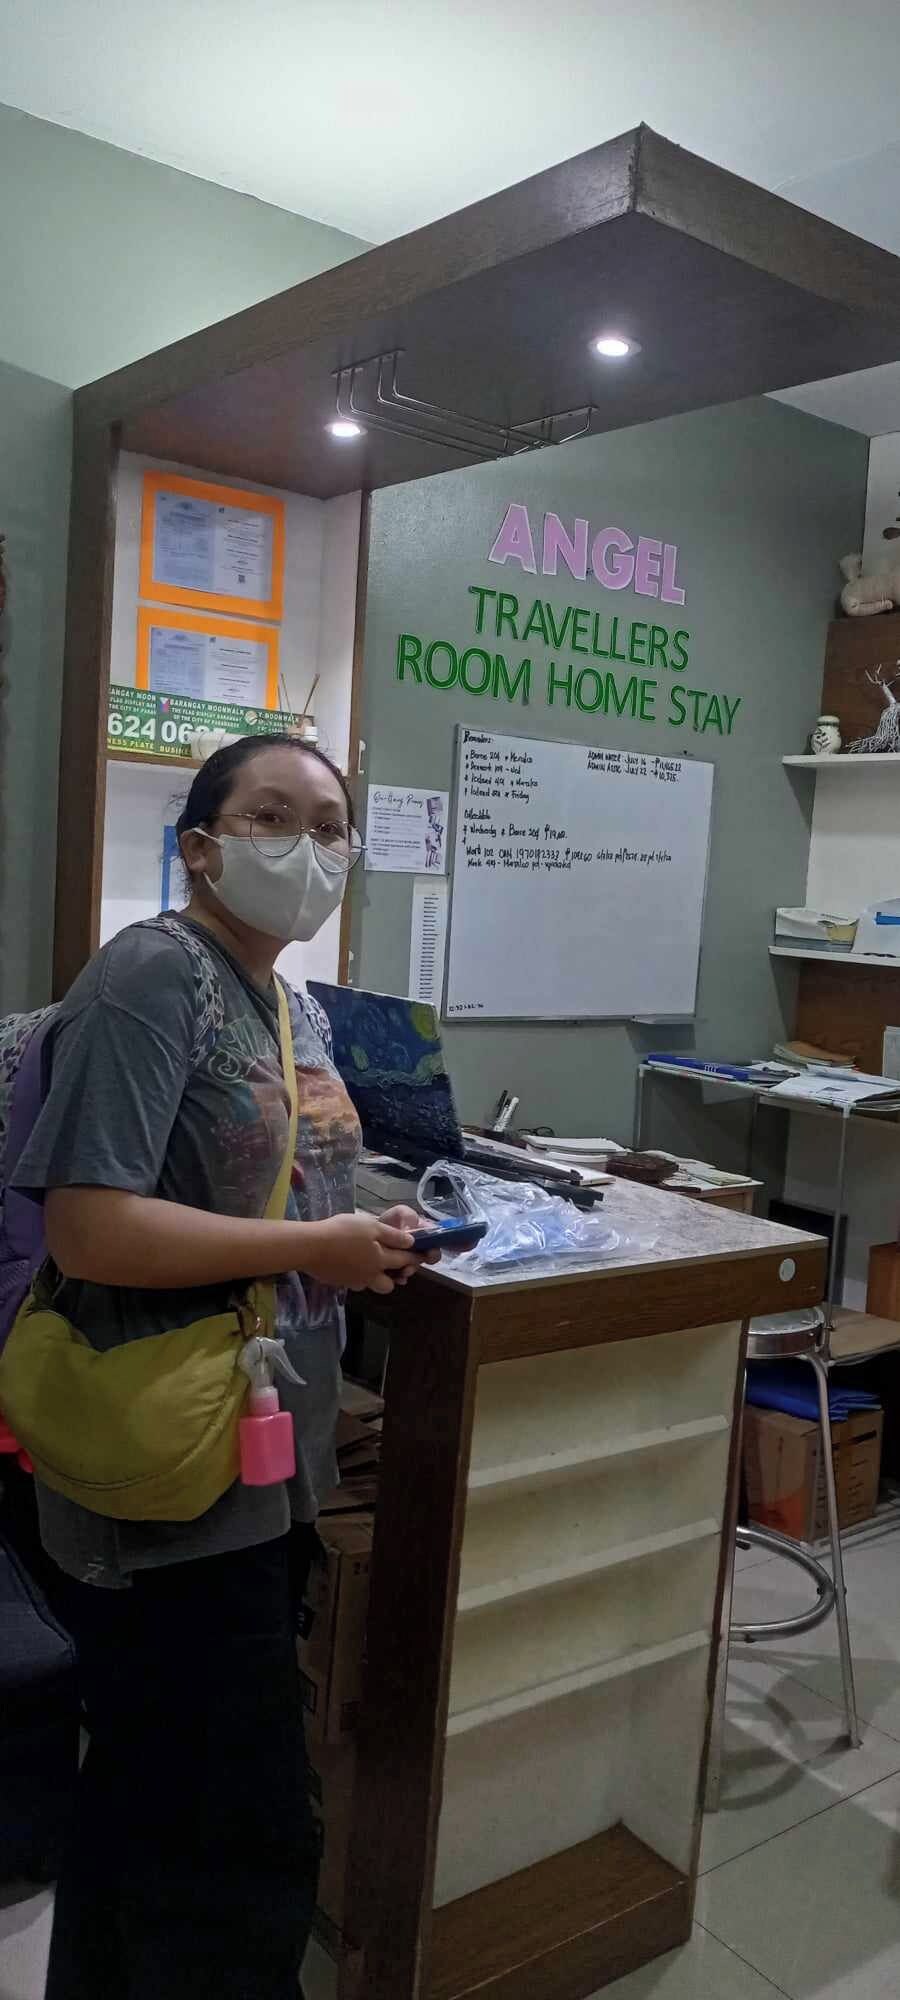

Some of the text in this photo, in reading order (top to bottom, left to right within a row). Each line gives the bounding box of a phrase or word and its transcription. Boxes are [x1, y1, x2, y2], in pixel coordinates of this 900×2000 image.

[487, 503, 686, 606] ANGEL
[468, 585, 690, 672] TRAVELLERS
[396, 633, 742, 736] ROOM HOME STAY
[169, 698, 245, 716] BARANGAY MOONWALK
[108, 712, 155, 741] 624
[129, 740, 154, 750] PLATE
[624, 754, 639, 765] JULY
[624, 763, 639, 775] JULY
